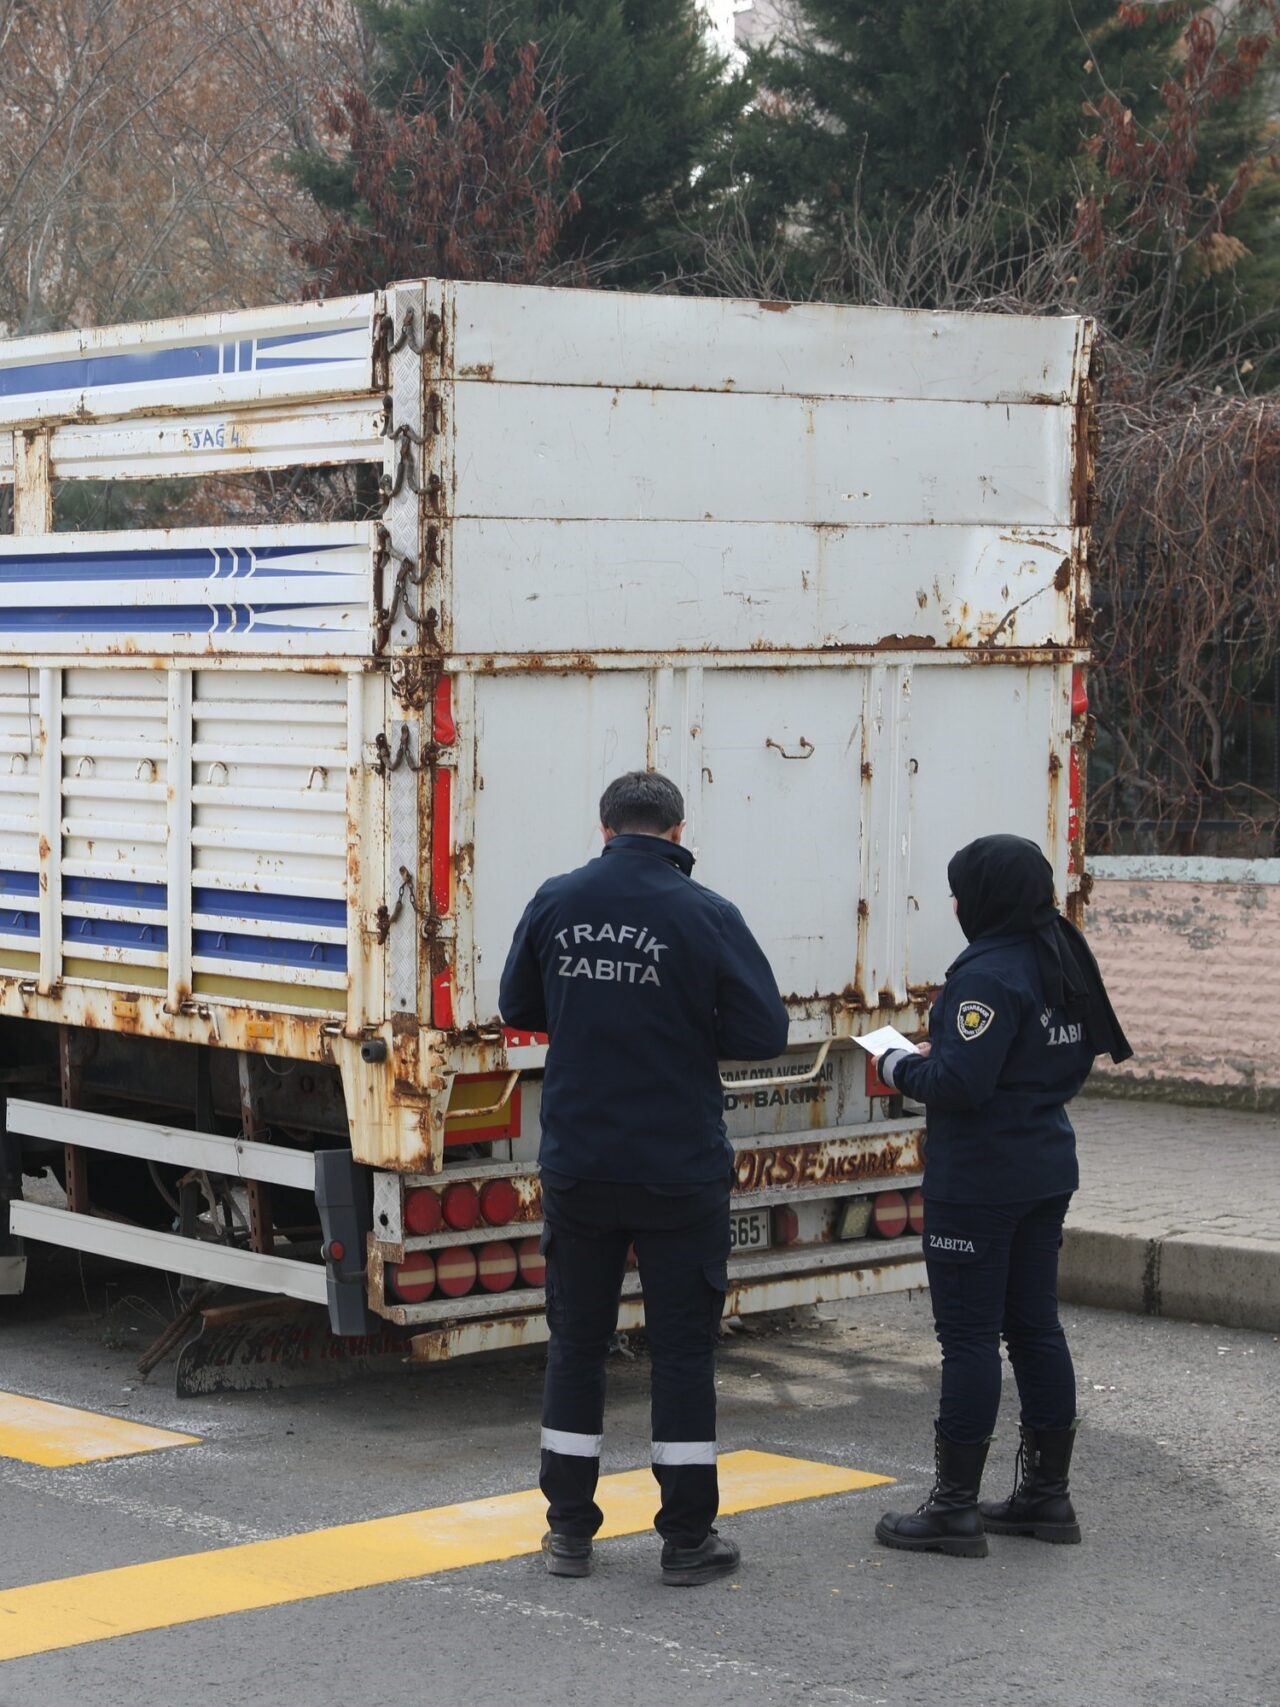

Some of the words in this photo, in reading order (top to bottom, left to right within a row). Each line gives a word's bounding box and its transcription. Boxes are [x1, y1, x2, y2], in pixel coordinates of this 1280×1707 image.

[554, 922, 669, 963] TRAFİK
[558, 955, 661, 987] ZABITA
[1046, 1022, 1083, 1046] ZABI
[824, 1148, 902, 1178] AKSARAY
[929, 1234, 975, 1253] ZABITA
